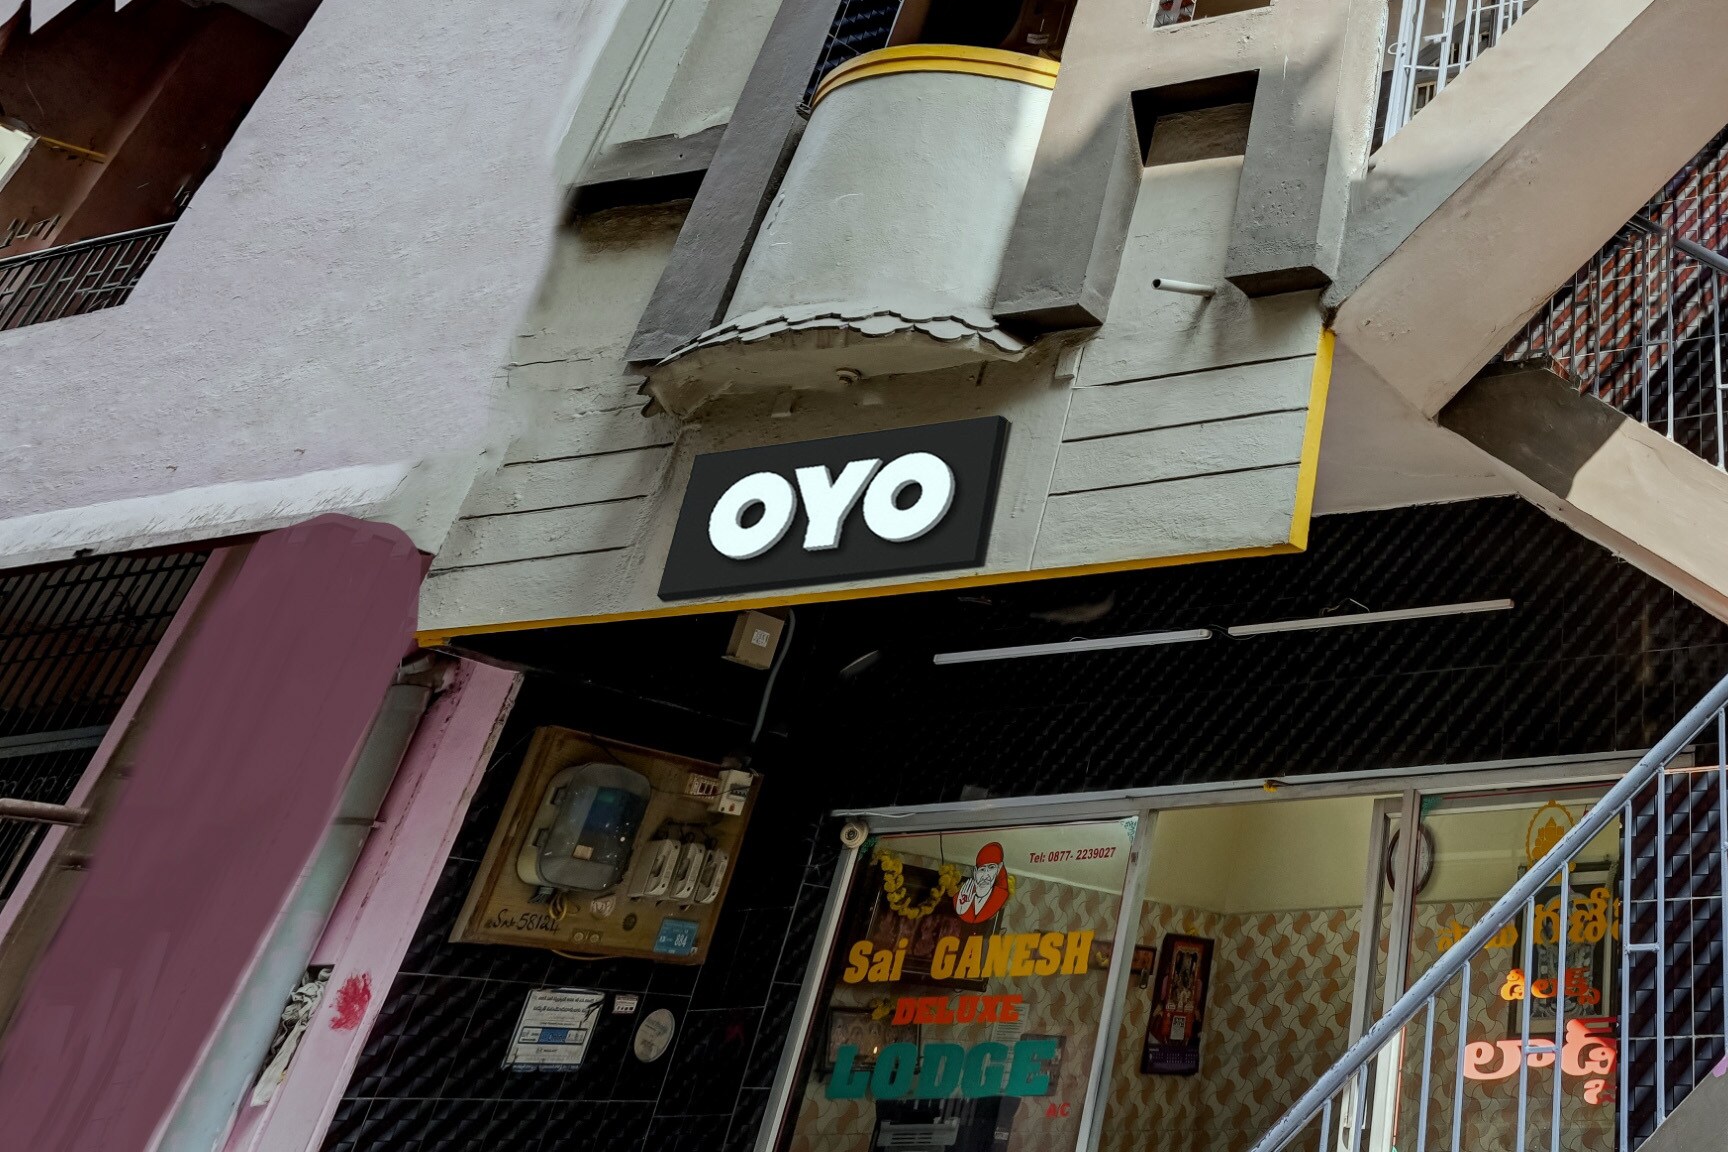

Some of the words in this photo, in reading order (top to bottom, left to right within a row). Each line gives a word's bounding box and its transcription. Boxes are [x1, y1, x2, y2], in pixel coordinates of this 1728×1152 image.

[708, 451, 955, 560] OYO
[1029, 851, 1045, 864] Tel:
[842, 938, 909, 984] Sai
[930, 930, 1095, 980] GANESH
[891, 994, 1024, 1026] DELUXE
[825, 1038, 1058, 1100] LODGE
